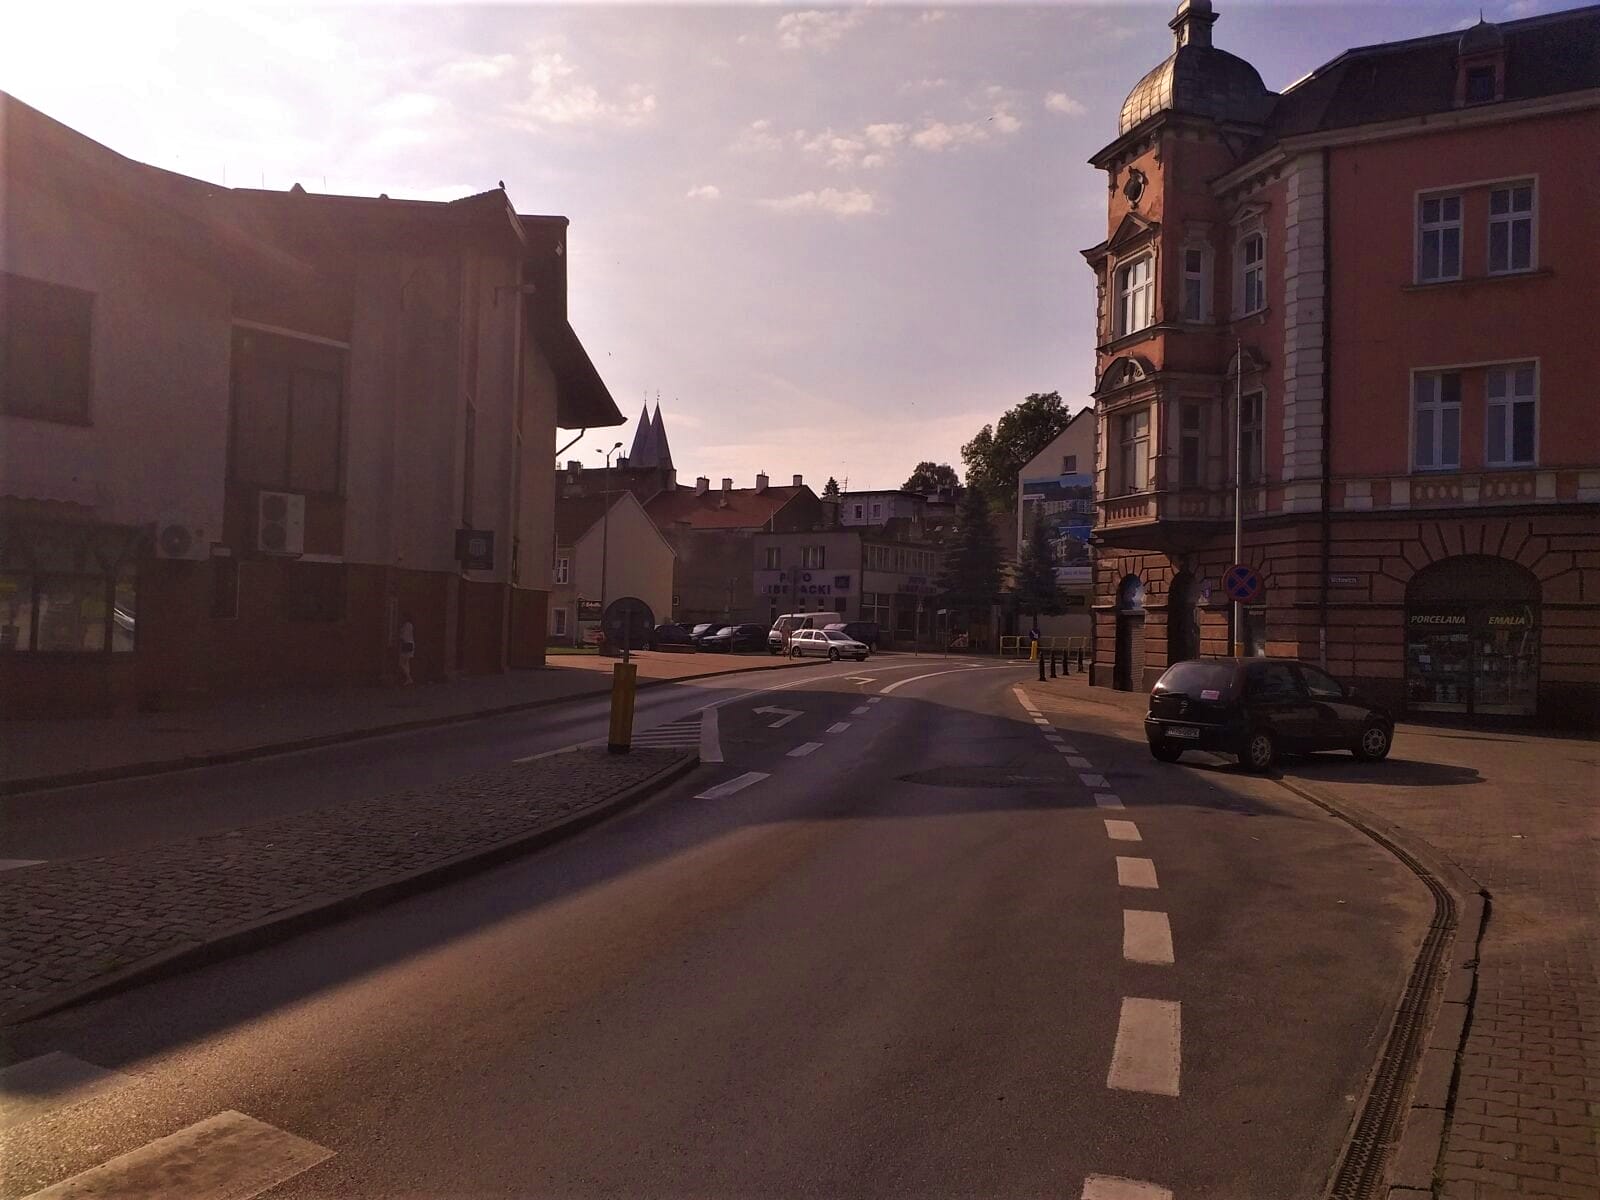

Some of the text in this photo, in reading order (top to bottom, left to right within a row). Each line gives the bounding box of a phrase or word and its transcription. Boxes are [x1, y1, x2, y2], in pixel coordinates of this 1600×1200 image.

[761, 584, 831, 595] LIBEACKI
[1409, 615, 1526, 625] PORCELANA EMALIA
